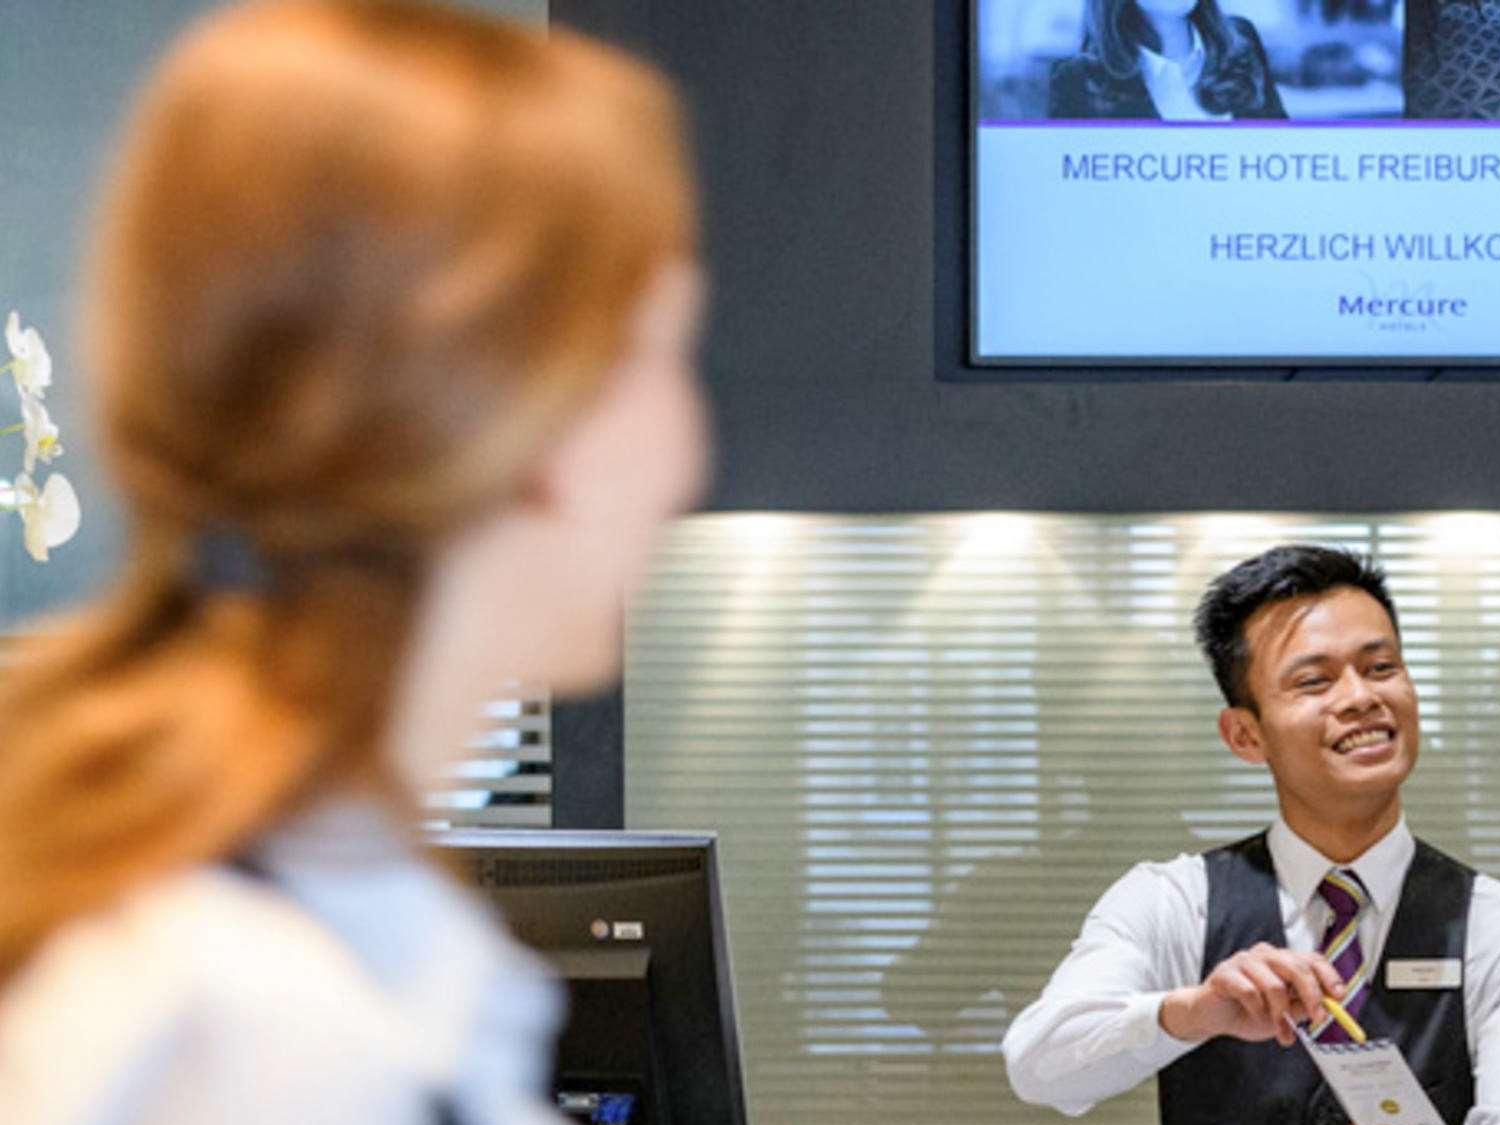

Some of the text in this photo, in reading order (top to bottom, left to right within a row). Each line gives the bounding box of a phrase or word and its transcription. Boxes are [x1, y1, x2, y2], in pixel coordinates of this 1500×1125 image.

[1061, 153, 1229, 182] MERCURE
[1239, 153, 1349, 182] HOTEL
[1209, 233, 1376, 261] HERZLICH
[1338, 294, 1468, 317] Mercure
